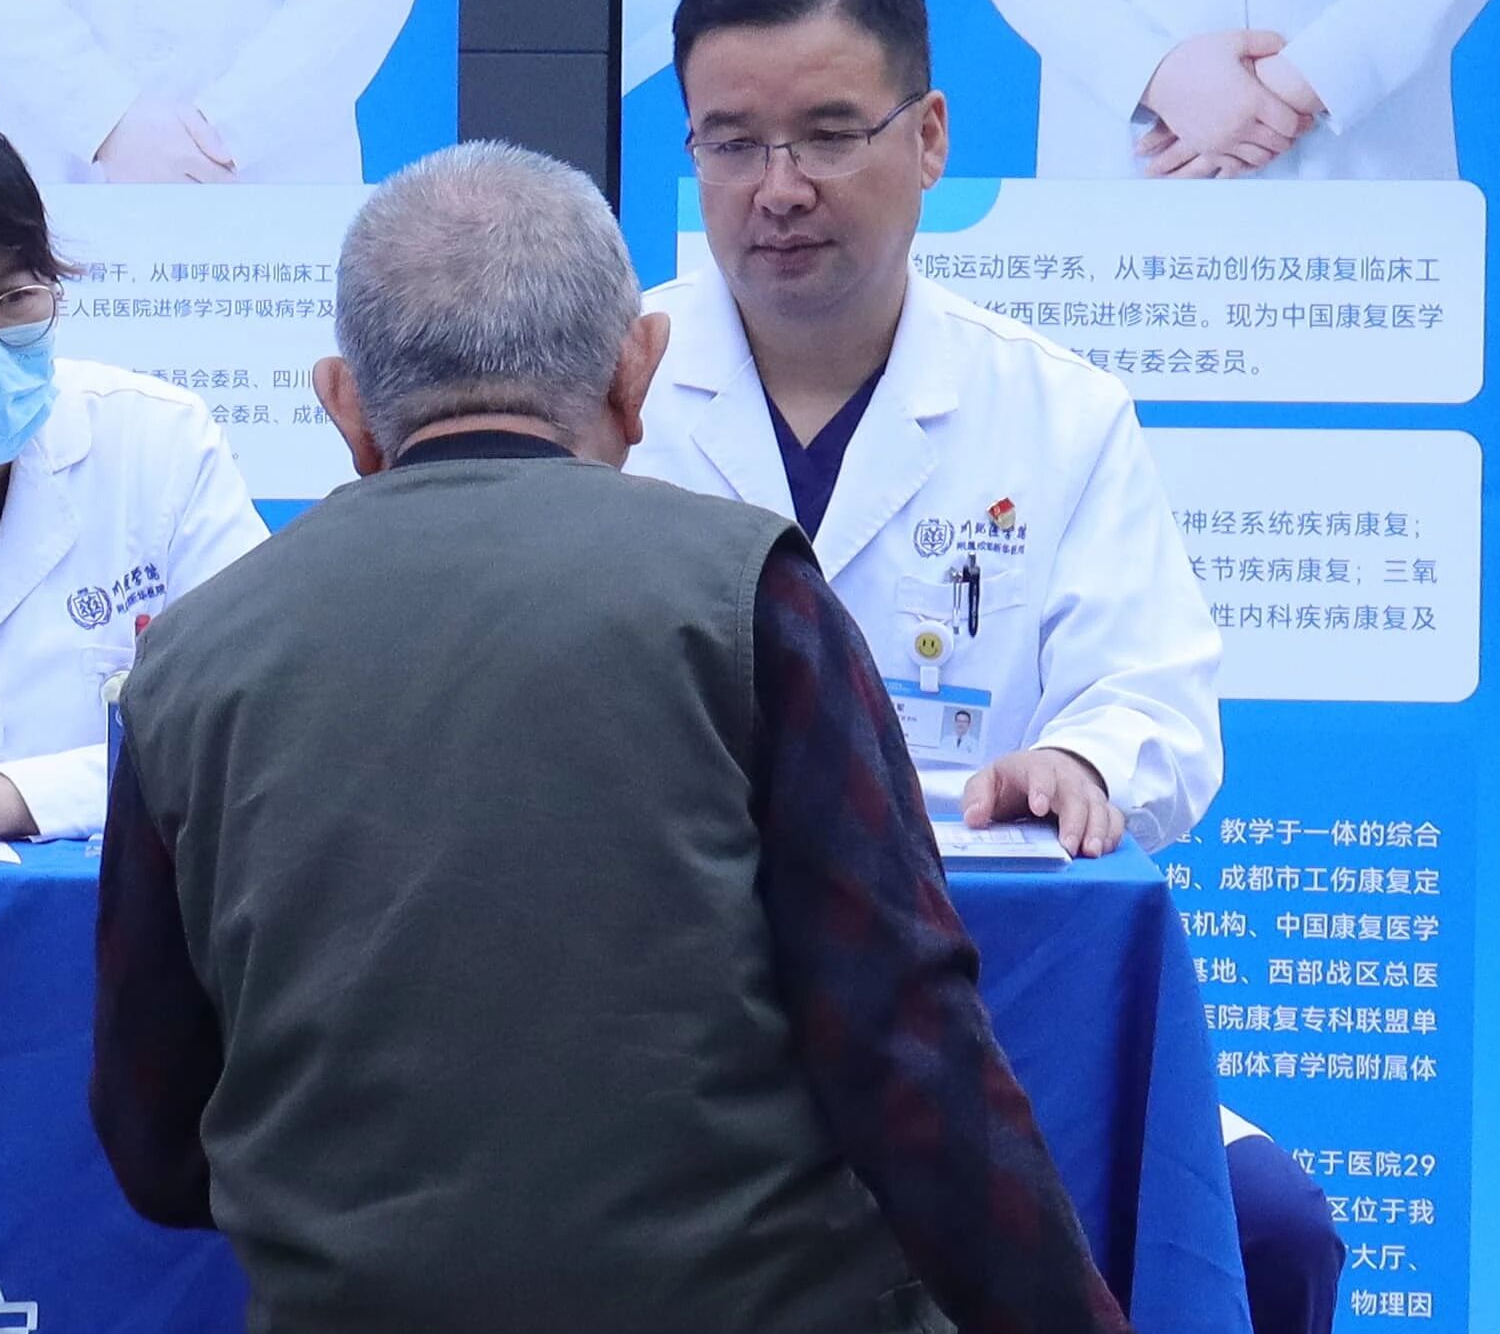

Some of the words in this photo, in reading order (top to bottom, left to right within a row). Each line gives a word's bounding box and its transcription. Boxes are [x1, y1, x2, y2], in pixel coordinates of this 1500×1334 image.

[972, 300, 1443, 331] 华西医院进修深造。现为中国康复医学
[1068, 347, 1262, 376] 复专委会委员。
[1172, 509, 1420, 540] 神经系统疾病康复；
[1209, 601, 1437, 632] 性内科疾病康复及
[1217, 1050, 1437, 1082] 都体育学院附属体
[1345, 1242, 1418, 1272] 大厅、
[1351, 1289, 1432, 1319] 物理因
